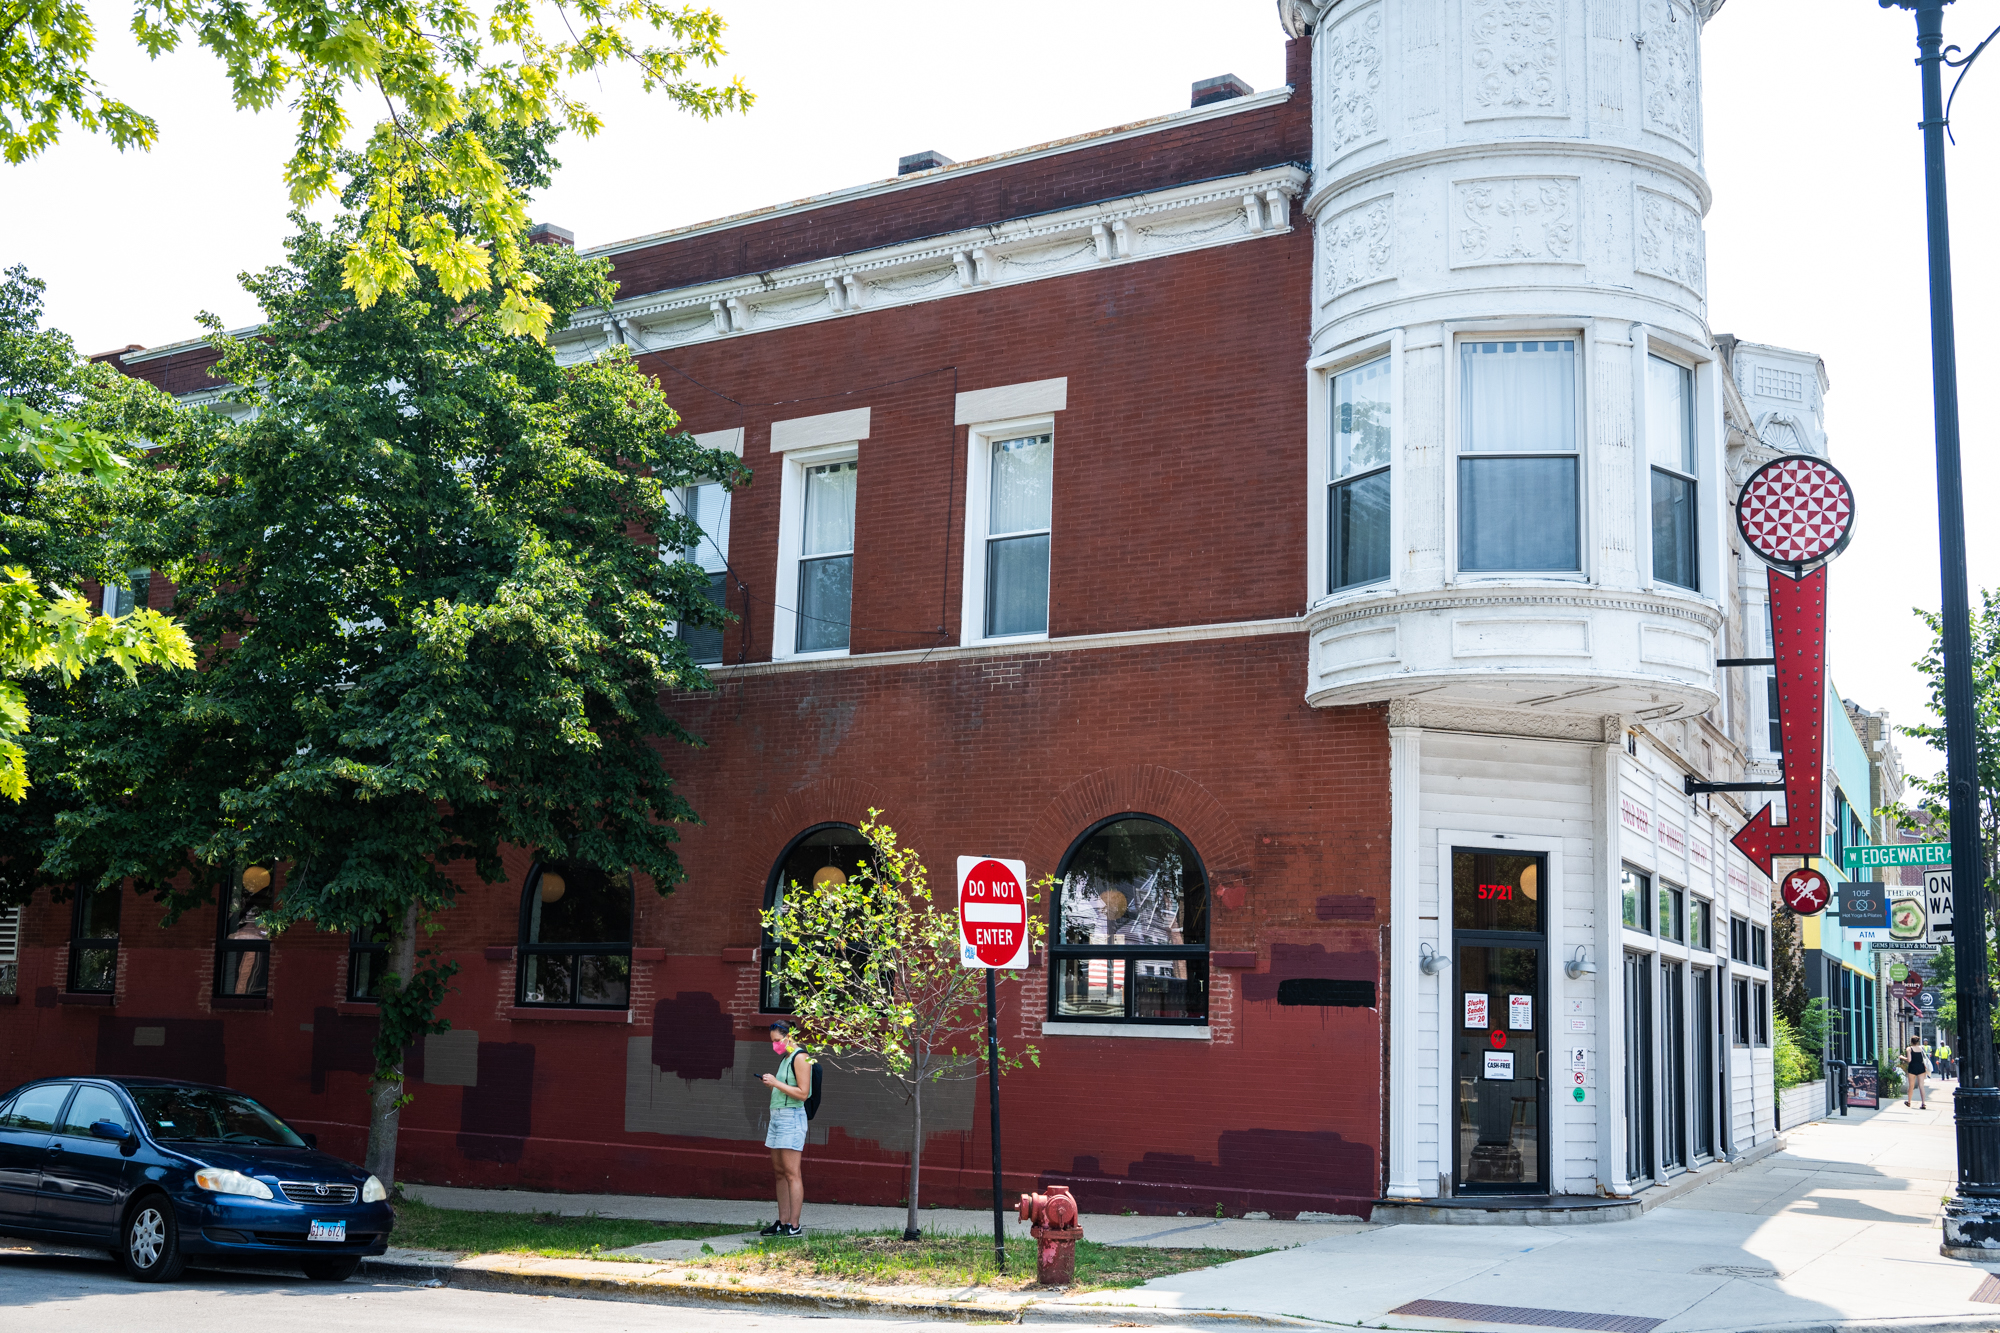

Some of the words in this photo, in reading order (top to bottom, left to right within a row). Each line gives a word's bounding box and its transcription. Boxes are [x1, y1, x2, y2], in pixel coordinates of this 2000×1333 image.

[1850, 853, 1857, 861] W
[1861, 847, 1945, 864] EDGEWATER
[968, 880, 985, 897] DO
[992, 881, 1015, 898] NOT
[1478, 884, 1513, 900] 5721
[1929, 876, 1952, 894] ON
[1929, 897, 1954, 914] WA
[976, 928, 1013, 945] ENTER
[1467, 999, 1485, 1007] Slushy
[327, 1225, 345, 1237] 6727
